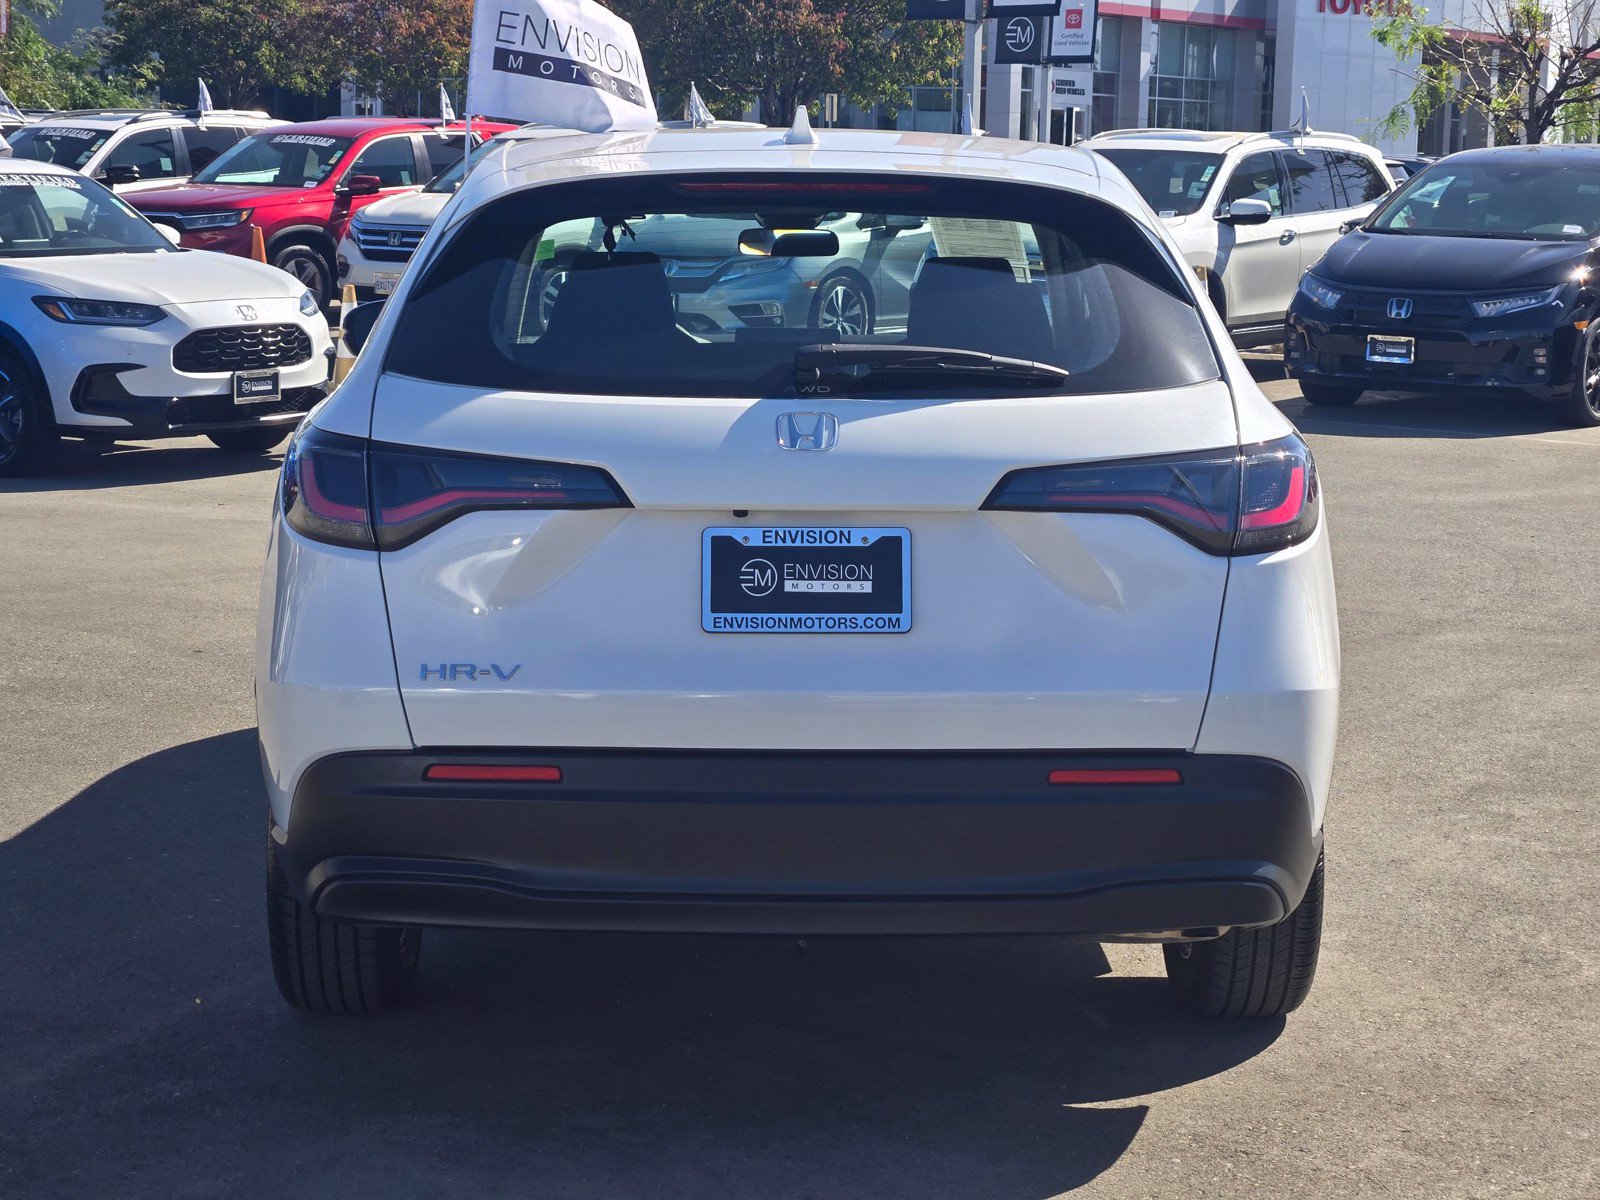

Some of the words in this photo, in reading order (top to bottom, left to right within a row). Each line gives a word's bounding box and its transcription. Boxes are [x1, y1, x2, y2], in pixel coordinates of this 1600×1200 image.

[495, 10, 641, 85] ENVISION
[507, 54, 636, 100] MOTORS
[0, 175, 77, 184] ERTIFIED
[784, 385, 830, 393] AWD
[761, 529, 852, 545] ENVISION
[783, 563, 873, 580] ENVISION
[791, 582, 865, 590] MOTORS
[712, 616, 901, 629] ENVISIONMOTORS.COM
[419, 663, 522, 681] HR-V
